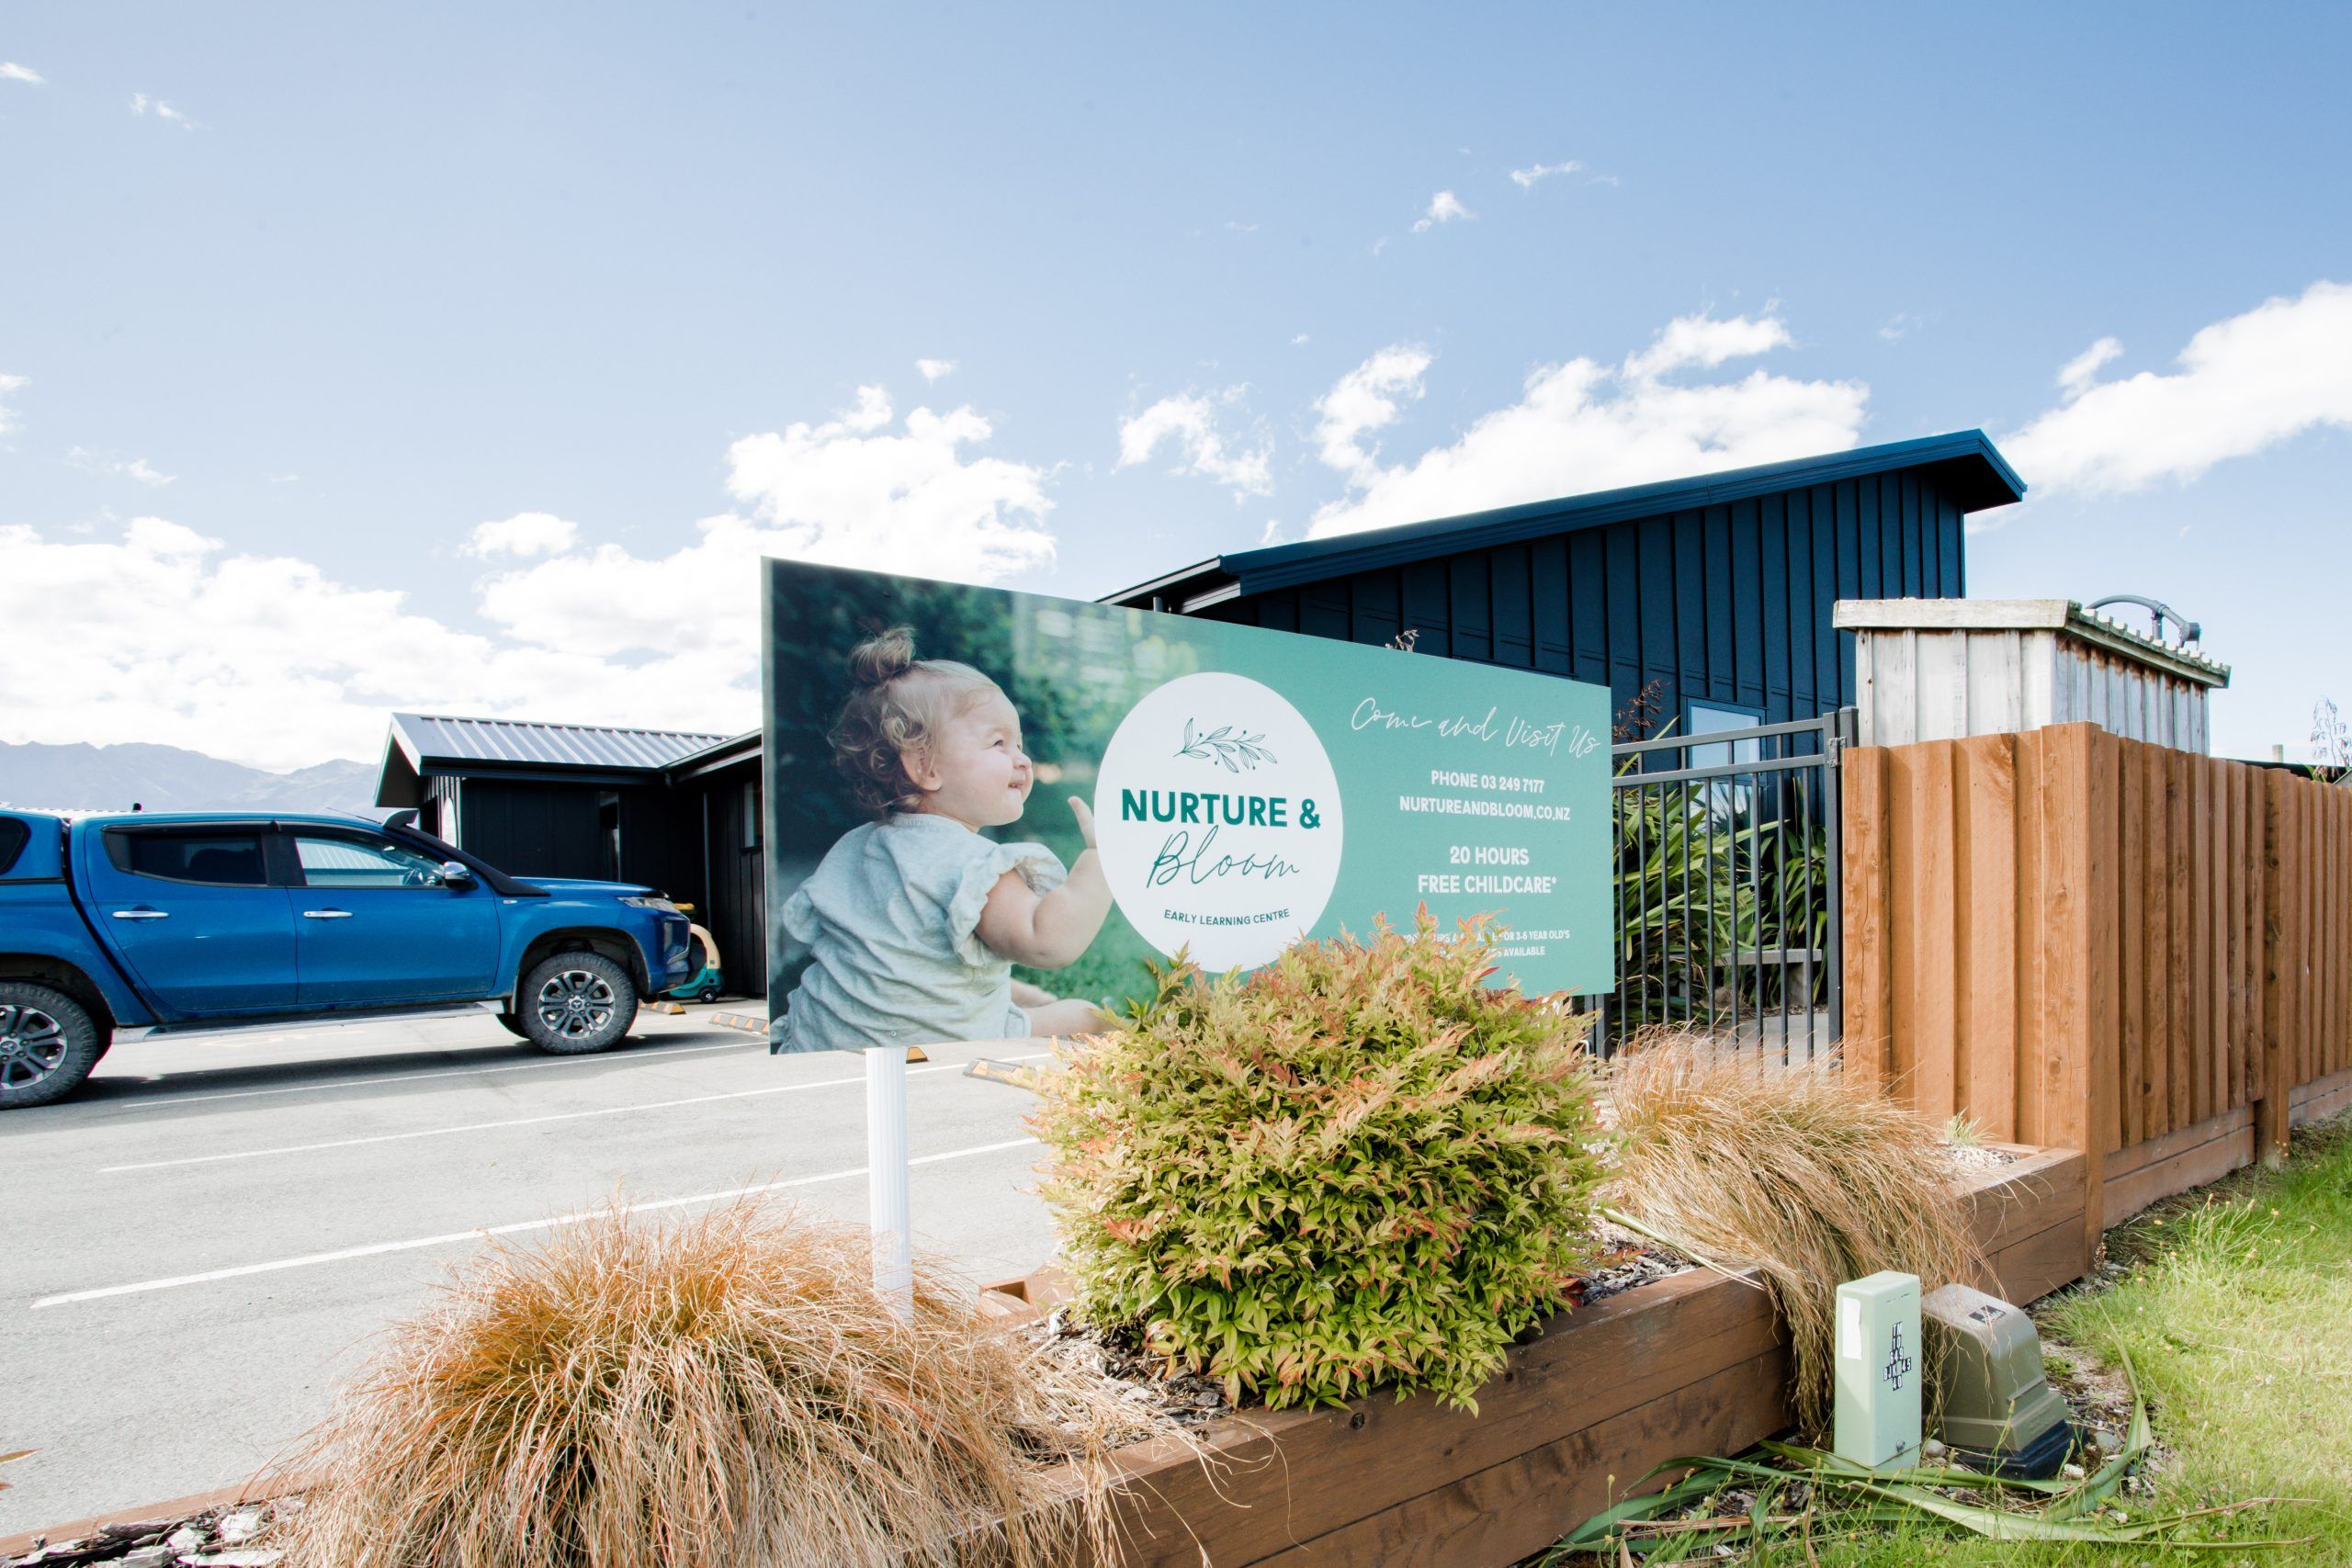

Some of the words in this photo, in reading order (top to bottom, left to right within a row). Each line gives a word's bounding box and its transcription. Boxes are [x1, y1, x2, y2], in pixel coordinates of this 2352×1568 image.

[1351, 696, 1432, 731] Come
[1438, 706, 1498, 741] and
[1506, 716, 1566, 757] Visit
[1569, 725, 1601, 759] Us
[1431, 770, 1478, 788] PHONE
[1481, 774, 1497, 789] 03
[1499, 777, 1521, 792] 249
[1522, 778, 1545, 794] 7177
[1121, 788, 1287, 827] NURTURE
[1298, 798, 1321, 829] &
[1399, 795, 1571, 821] NURTUREANDBLOOM.CO.NZ
[1146, 825, 1300, 889] Bloom
[1450, 845, 1471, 864] 20
[1475, 846, 1530, 866] HOURS
[1418, 874, 1460, 893] FREE
[1164, 908, 1197, 925] EARLY
[1199, 915, 1251, 926] LEARNING
[1253, 908, 1290, 924] CENTRE
[1516, 931, 1528, 942] 3-6
[1529, 931, 1548, 941] YEAR
[1549, 930, 1571, 940] OLD'S
[1503, 946, 1546, 957] AVAILABLE
